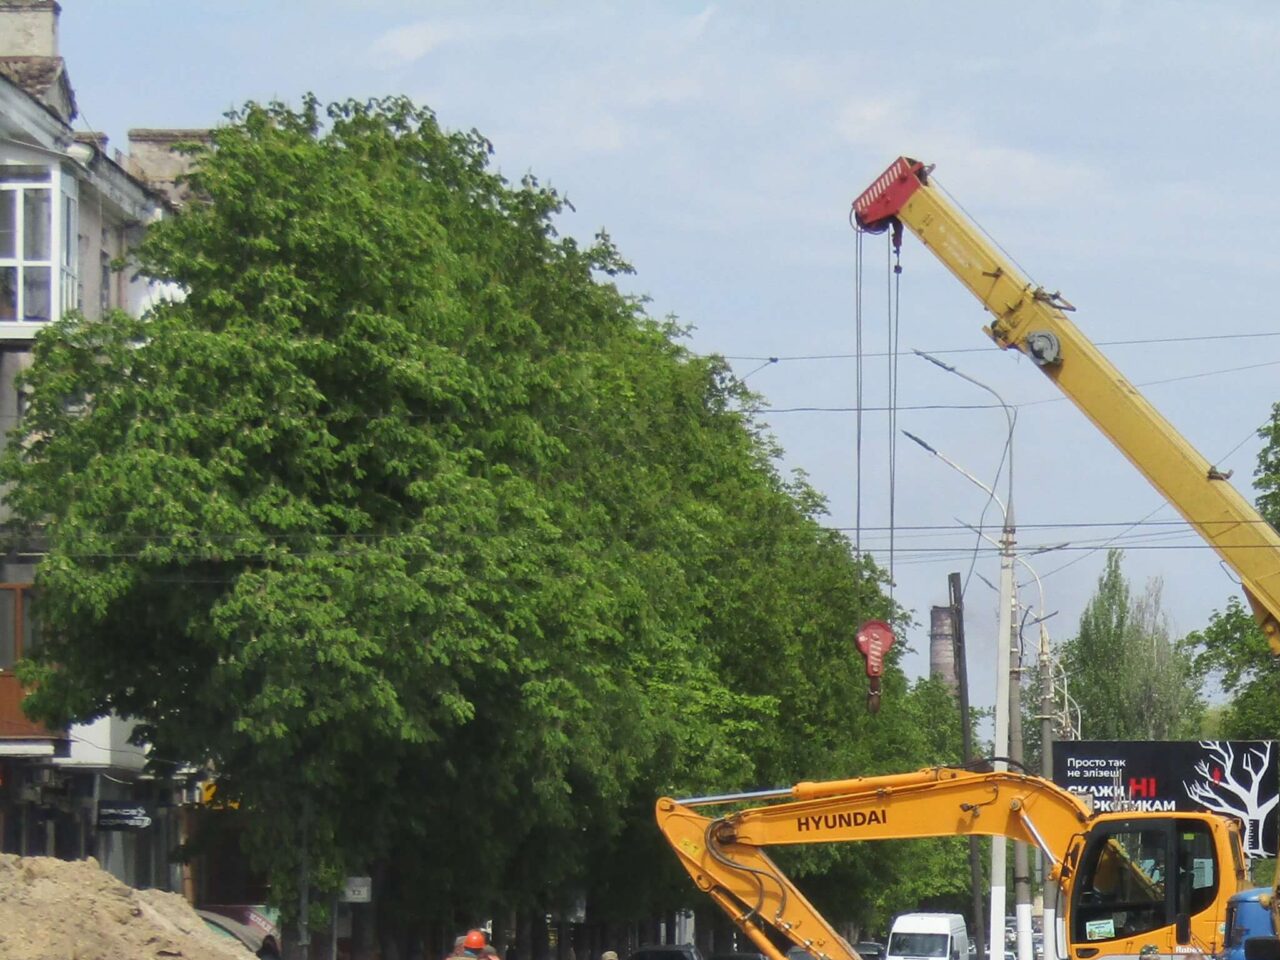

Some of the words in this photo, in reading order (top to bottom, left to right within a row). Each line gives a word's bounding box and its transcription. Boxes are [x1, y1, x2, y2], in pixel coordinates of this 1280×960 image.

[1067, 757, 1106, 769] Просто
[1108, 759, 1126, 767] так
[1067, 770, 1081, 778] не
[1129, 777, 1157, 798] НІ
[1093, 800, 1176, 812] РКОТИКАМ
[797, 809, 887, 832] HYUNDAI
